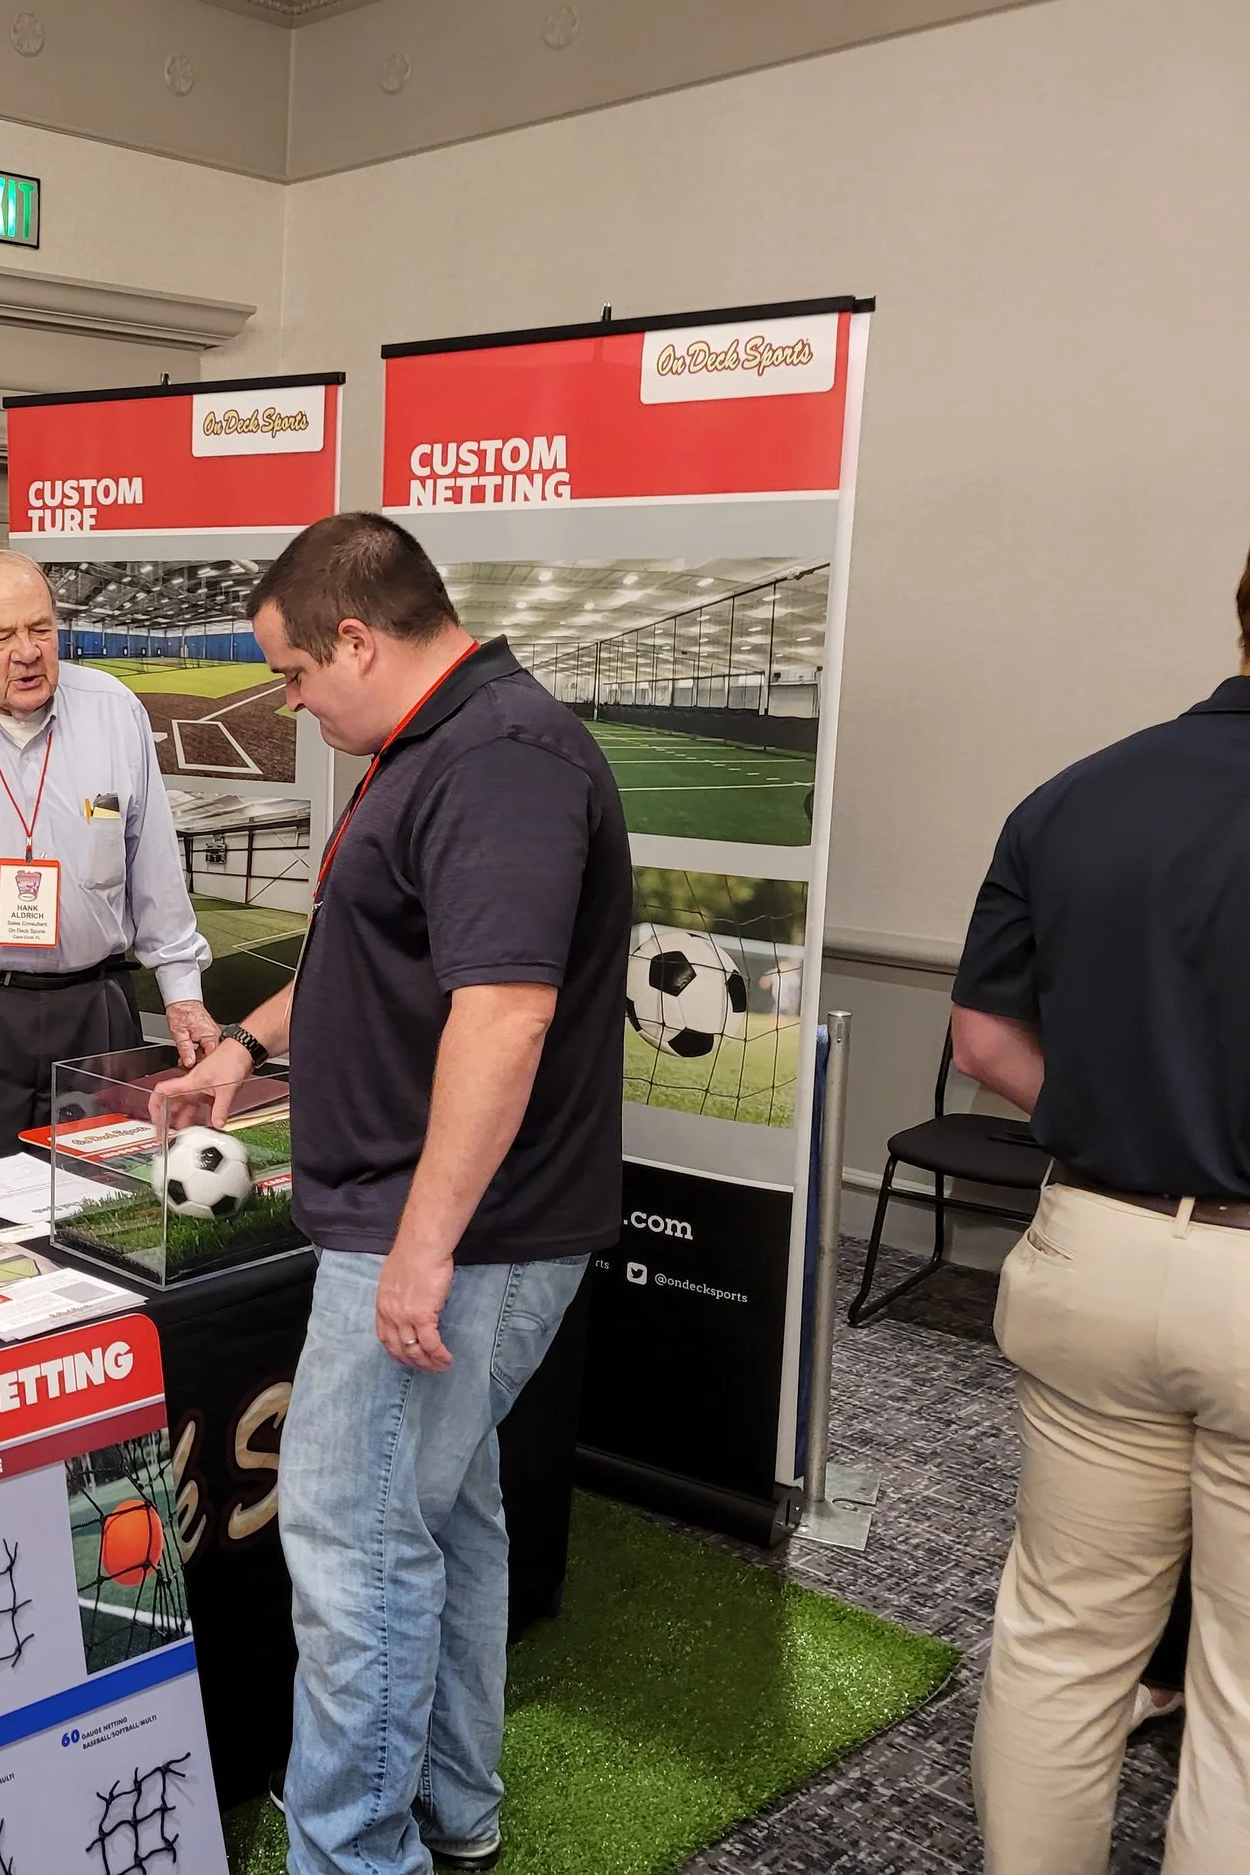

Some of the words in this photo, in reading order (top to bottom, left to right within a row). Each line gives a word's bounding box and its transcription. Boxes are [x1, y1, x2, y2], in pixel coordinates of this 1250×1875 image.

[656, 344, 687, 377] On
[686, 340, 739, 376] Deck
[742, 335, 814, 376] Sports
[203, 411, 223, 436] On
[223, 409, 260, 435] Deck
[260, 407, 309, 438] Sports
[410, 434, 567, 477] CUSTOM
[28, 476, 143, 507] CUSTOM
[409, 471, 572, 508] NETTING
[28, 507, 97, 532] TURF
[654, 1273, 748, 1303] @ondecksports
[61, 1729, 80, 1747] 60
[81, 1726, 102, 1740] GAUGE
[103, 1716, 128, 1731] NETTING
[82, 1714, 157, 1750] BASEBALL/SOFTBALL/MULTI
